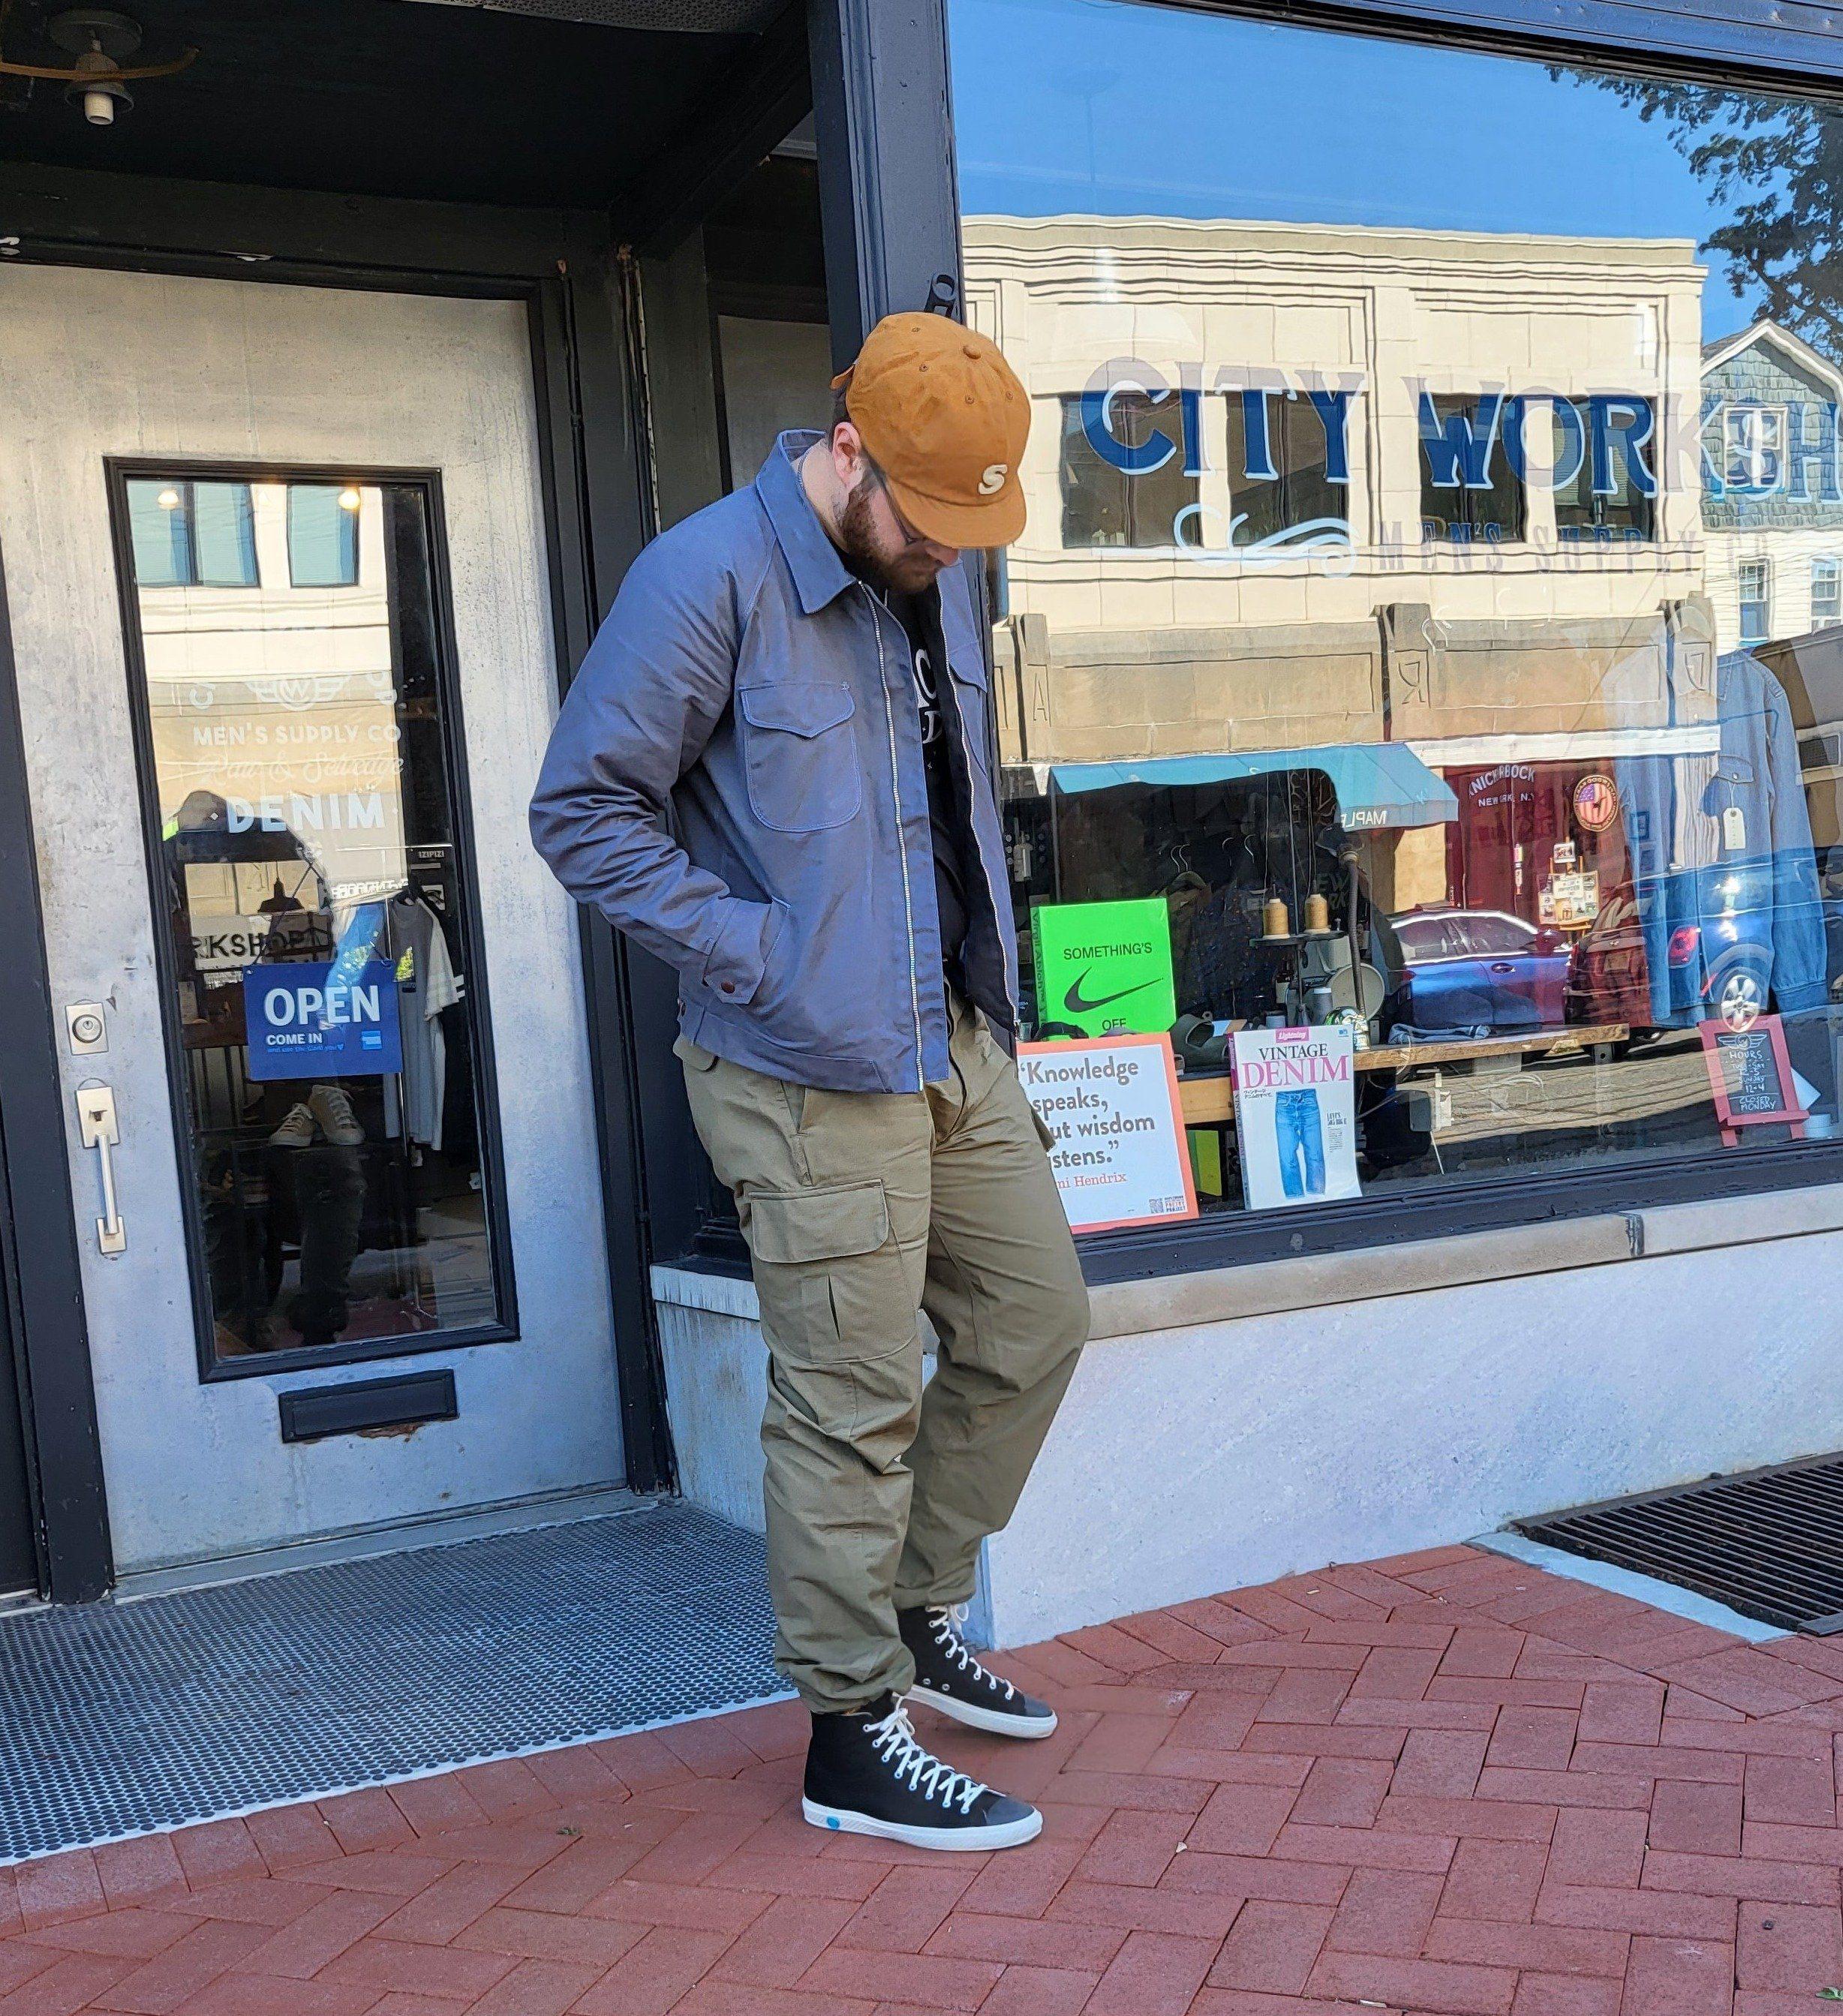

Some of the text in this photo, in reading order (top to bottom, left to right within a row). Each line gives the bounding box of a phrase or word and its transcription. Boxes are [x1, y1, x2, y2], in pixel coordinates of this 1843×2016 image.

[1080, 356, 1365, 483] CITY
[978, 464, 1008, 494] S
[1378, 520, 1504, 573] MEN'S
[193, 722, 401, 746] MEN'S SUPPLY CO
[227, 793, 385, 833] DENIM
[1063, 942, 1153, 960] SOMETHING'S
[264, 984, 381, 1026] OPEN
[1102, 1017, 1127, 1032] OFF
[266, 1032, 322, 1046] COME IN
[1258, 1043, 1328, 1060] VINTAGE
[1729, 1050, 1763, 1059] HOURS
[1242, 1055, 1350, 1088] DENIM
[1033, 1087, 1108, 1121] speaks,
[1739, 1095, 1770, 1104] CLOSED
[1741, 1101, 1776, 1111] MONDAY
[1050, 1111, 1156, 1140] ut wisdom
[1052, 1140, 1119, 1169] stens.”
[1074, 1172, 1128, 1187] Hendrix
